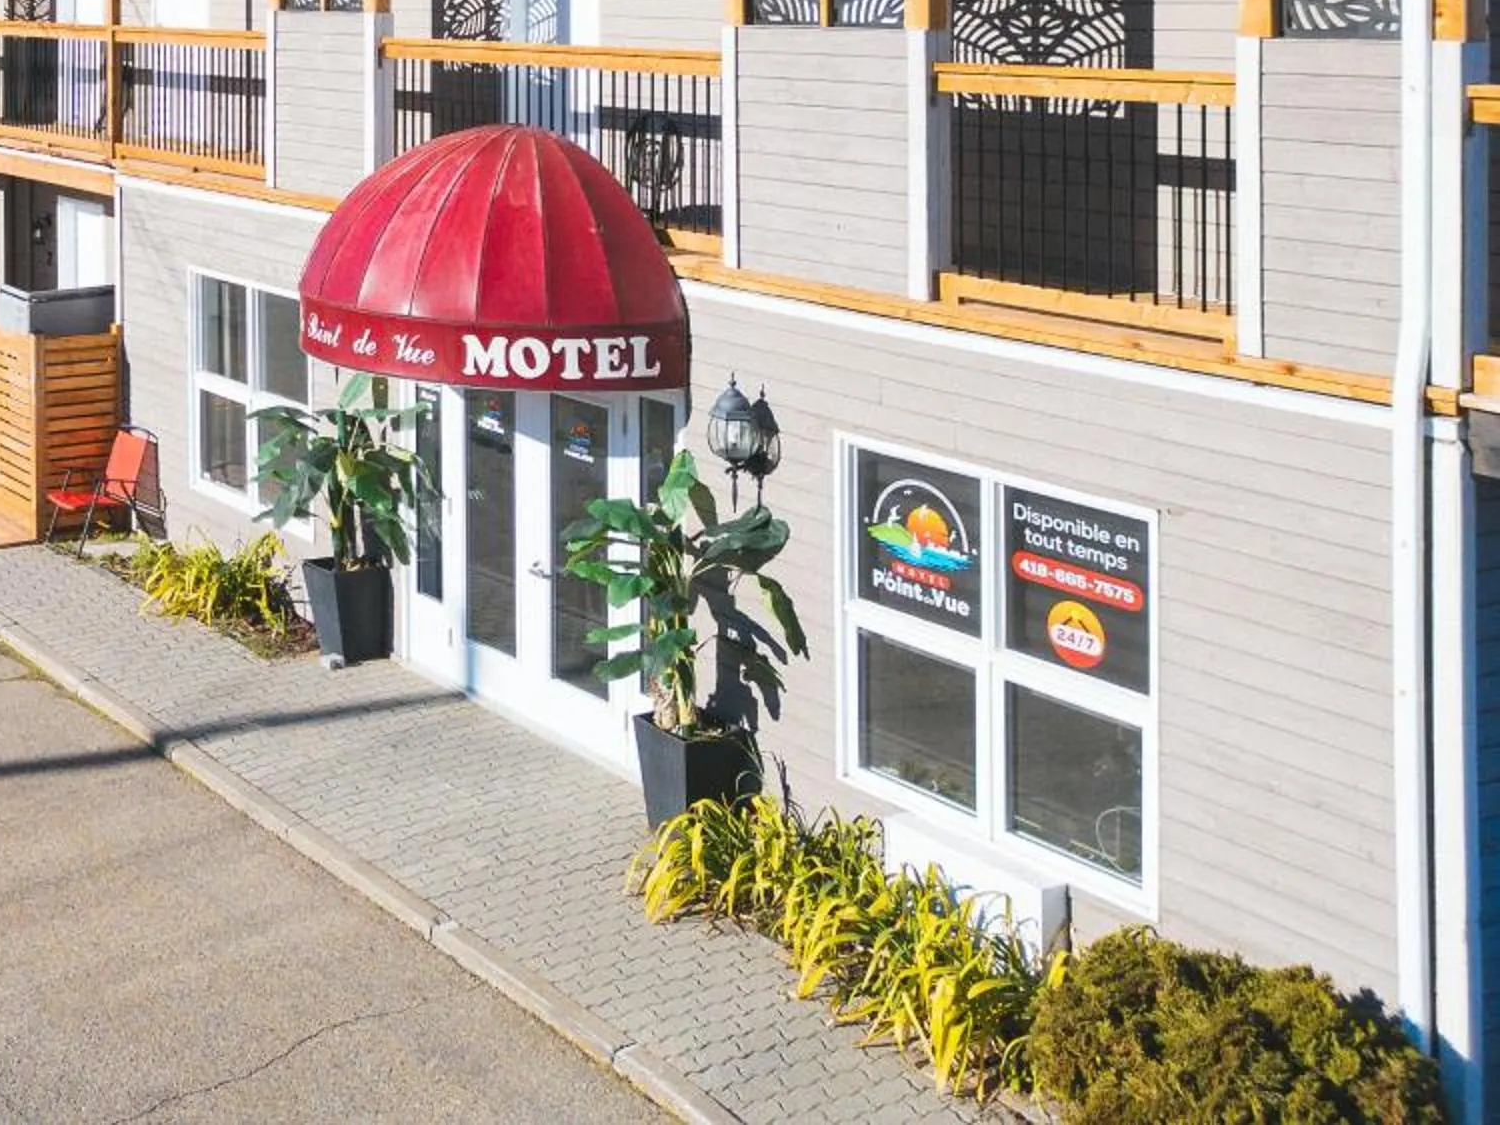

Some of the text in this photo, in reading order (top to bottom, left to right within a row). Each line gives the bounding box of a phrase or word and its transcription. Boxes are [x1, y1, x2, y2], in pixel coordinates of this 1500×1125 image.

[352, 328, 377, 356] de
[392, 333, 436, 365] Vue
[462, 334, 661, 379] MOTEL
[1013, 503, 1140, 552] Disponible en
[1024, 527, 1128, 571] tout temps
[872, 568, 923, 602] Point
[931, 588, 971, 617] Vue
